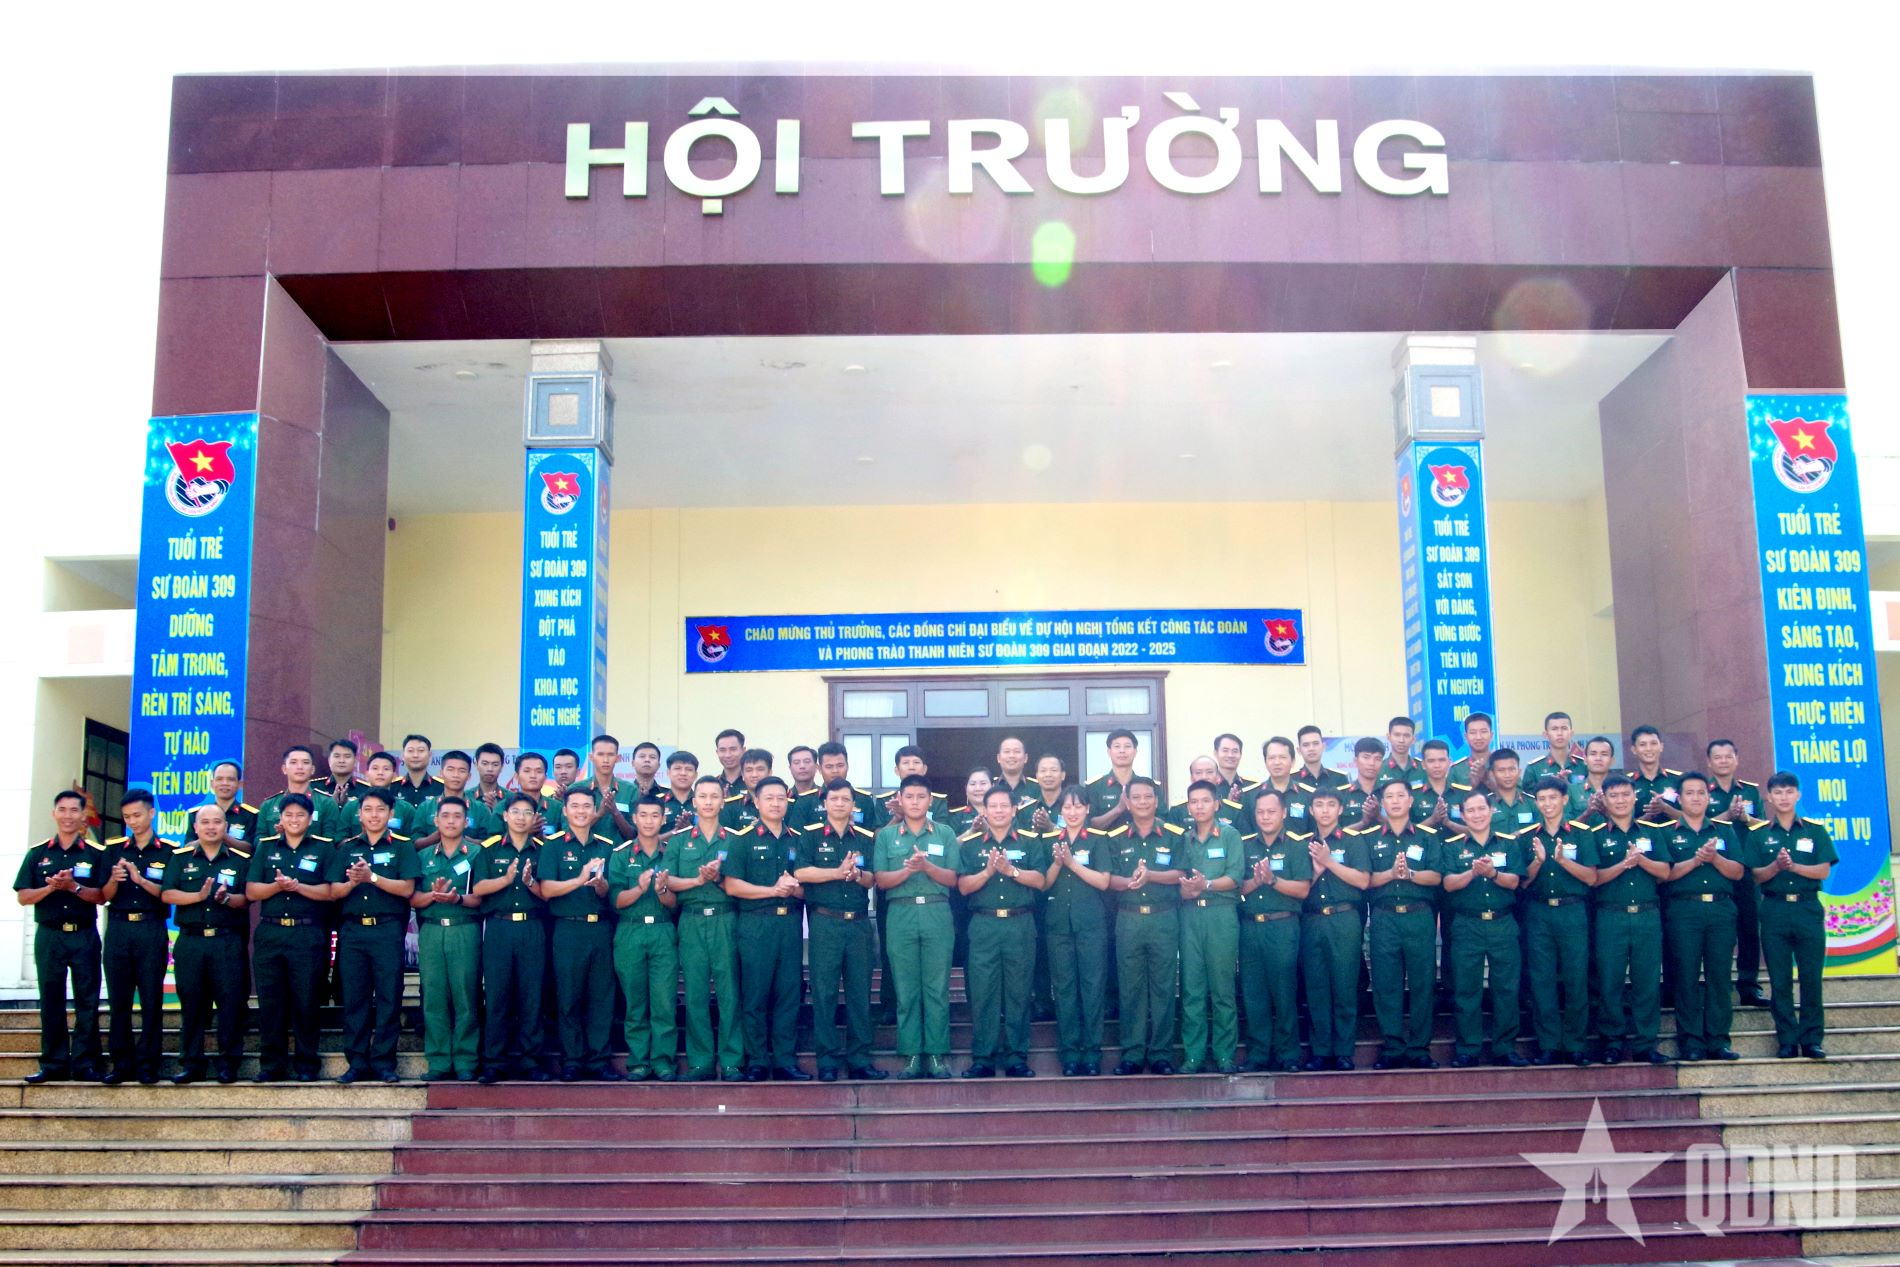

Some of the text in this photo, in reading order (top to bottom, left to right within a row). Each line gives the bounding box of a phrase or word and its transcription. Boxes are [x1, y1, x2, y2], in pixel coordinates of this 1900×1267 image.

[565, 92, 1449, 215] HỘI TRƯỜNG
[1777, 503, 1842, 535] TUỔI TRẺ
[168, 526, 224, 560] TUỔI TRẺ
[540, 522, 579, 549] TUỔI TRẺ
[530, 555, 587, 578] SƯ ĐOÀN 309
[1464, 545, 1481, 563] 309
[1765, 545, 1862, 573] SƯ ĐOÀN 309
[151, 570, 236, 599] SƯ ĐOÀN 309
[534, 585, 582, 608] XUNG KÍCH
[1777, 583, 1857, 615] KIÊN ĐỊNH,
[169, 608, 214, 637] DƯỠNG
[538, 615, 576, 641] ĐỘT PHÁ
[744, 616, 1248, 641] CHÀO MỪNG THỦ TRƯỞNG, CÁC ĐỒNG CHÍ ĐẠI BIỂU VỀ DỰ HỘI NGHỊ TỔNG KẾT CÔNG TÁC ĐOÀN
[1781, 621, 1859, 653] SÁNG TẠO,
[151, 649, 229, 679] TÂM TRONG,
[547, 644, 566, 667] VÀO
[818, 644, 833, 661] VÀ
[835, 647, 874, 661] PHONG
[876, 643, 906, 660] TRÀO
[908, 644, 945, 660] THANH
[947, 641, 975, 659] NIÊN
[977, 642, 994, 658] SƯ
[995, 640, 1027, 658] ĐOÀN
[1029, 643, 1050, 658] 309
[1053, 642, 1076, 658] GIAI
[1078, 642, 1109, 661] ĐOẠN
[1111, 642, 1139, 657] 2022
[1149, 641, 1176, 656] 2025
[1440, 646, 1479, 669] TIẾN VÀO
[1436, 671, 1484, 696] KỶ NGUYÊN
[1783, 658, 1863, 687] XUNG KÍCH
[141, 687, 235, 718] RÈN TRÍ SÁNG,
[534, 677, 579, 701] KHOA HỌC
[530, 704, 582, 731] CÔNG NGHỆ
[1787, 696, 1865, 730] THỰC HIỆN
[164, 726, 210, 761] TỰ HÀO
[1790, 732, 1868, 769] THẮNG LỢI
[151, 762, 215, 796] TIẾN BƯỚ
[1817, 778, 1847, 808] MỌI
[1851, 817, 1872, 846] VỤ
